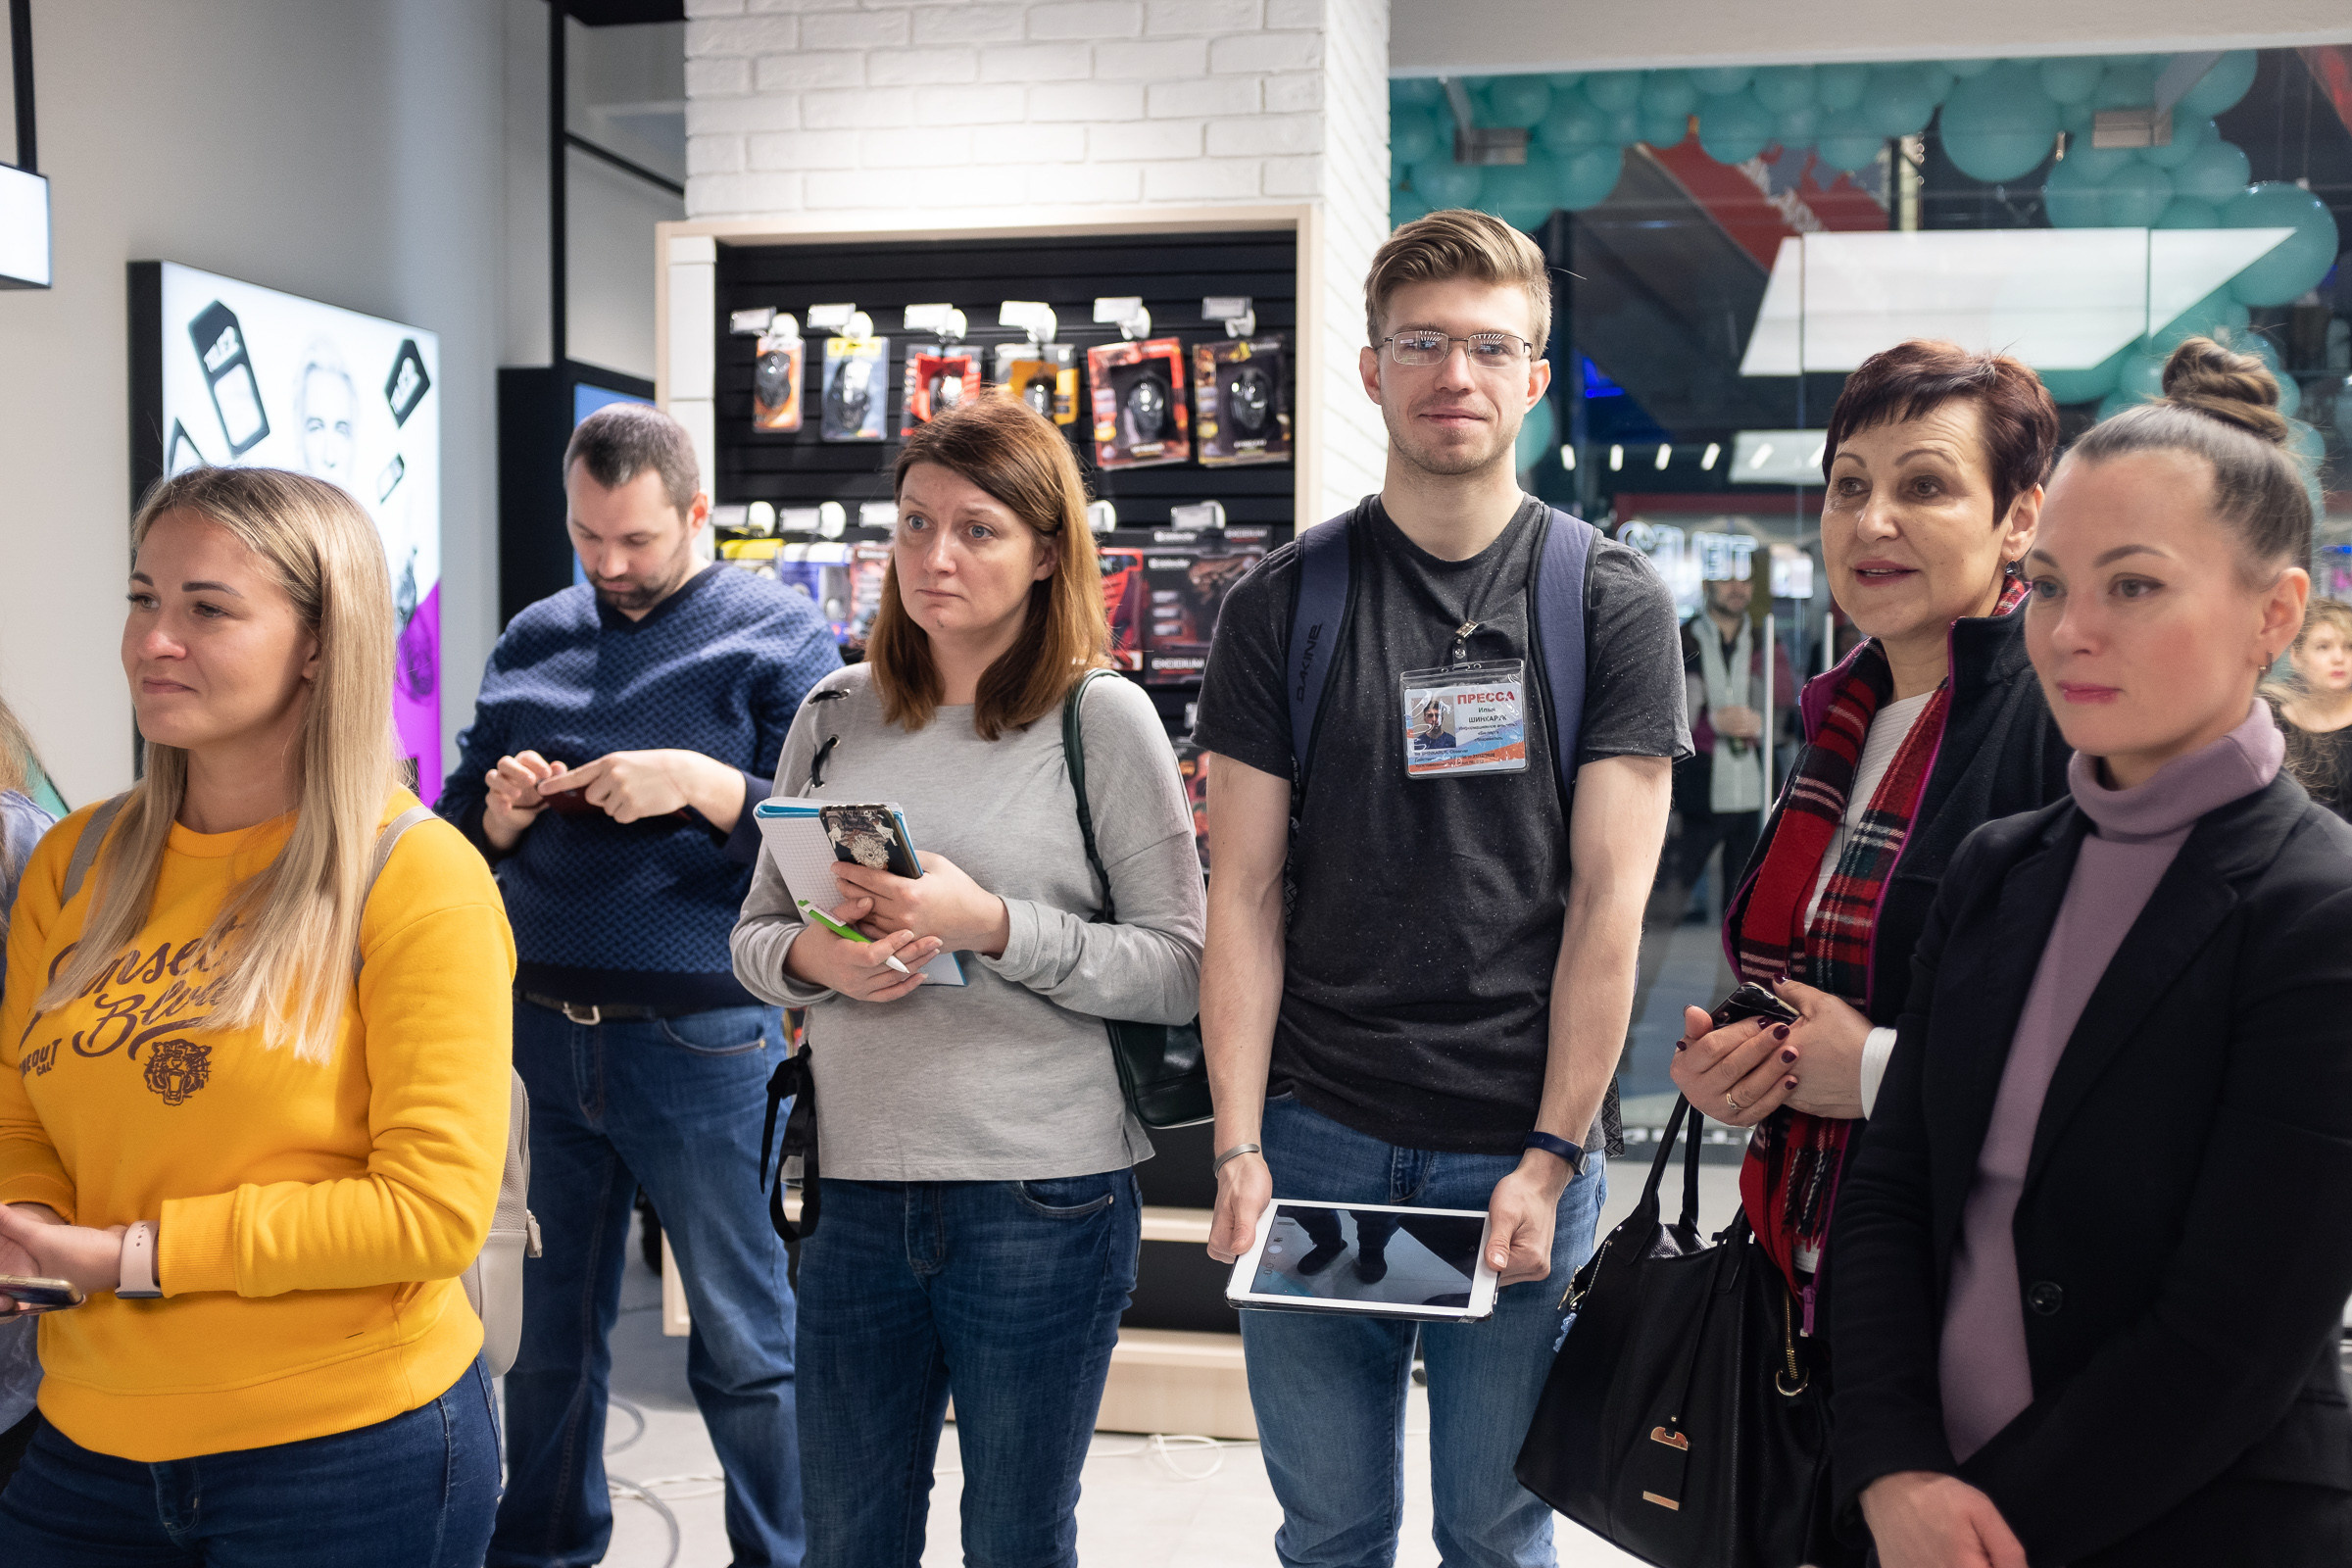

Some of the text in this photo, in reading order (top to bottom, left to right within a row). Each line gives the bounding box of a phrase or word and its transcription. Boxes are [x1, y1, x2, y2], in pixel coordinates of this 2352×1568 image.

[1297, 623, 1323, 705] DAKINE
[1457, 691, 1515, 705] ПРЕССА
[36, 1061, 52, 1077] CAL
